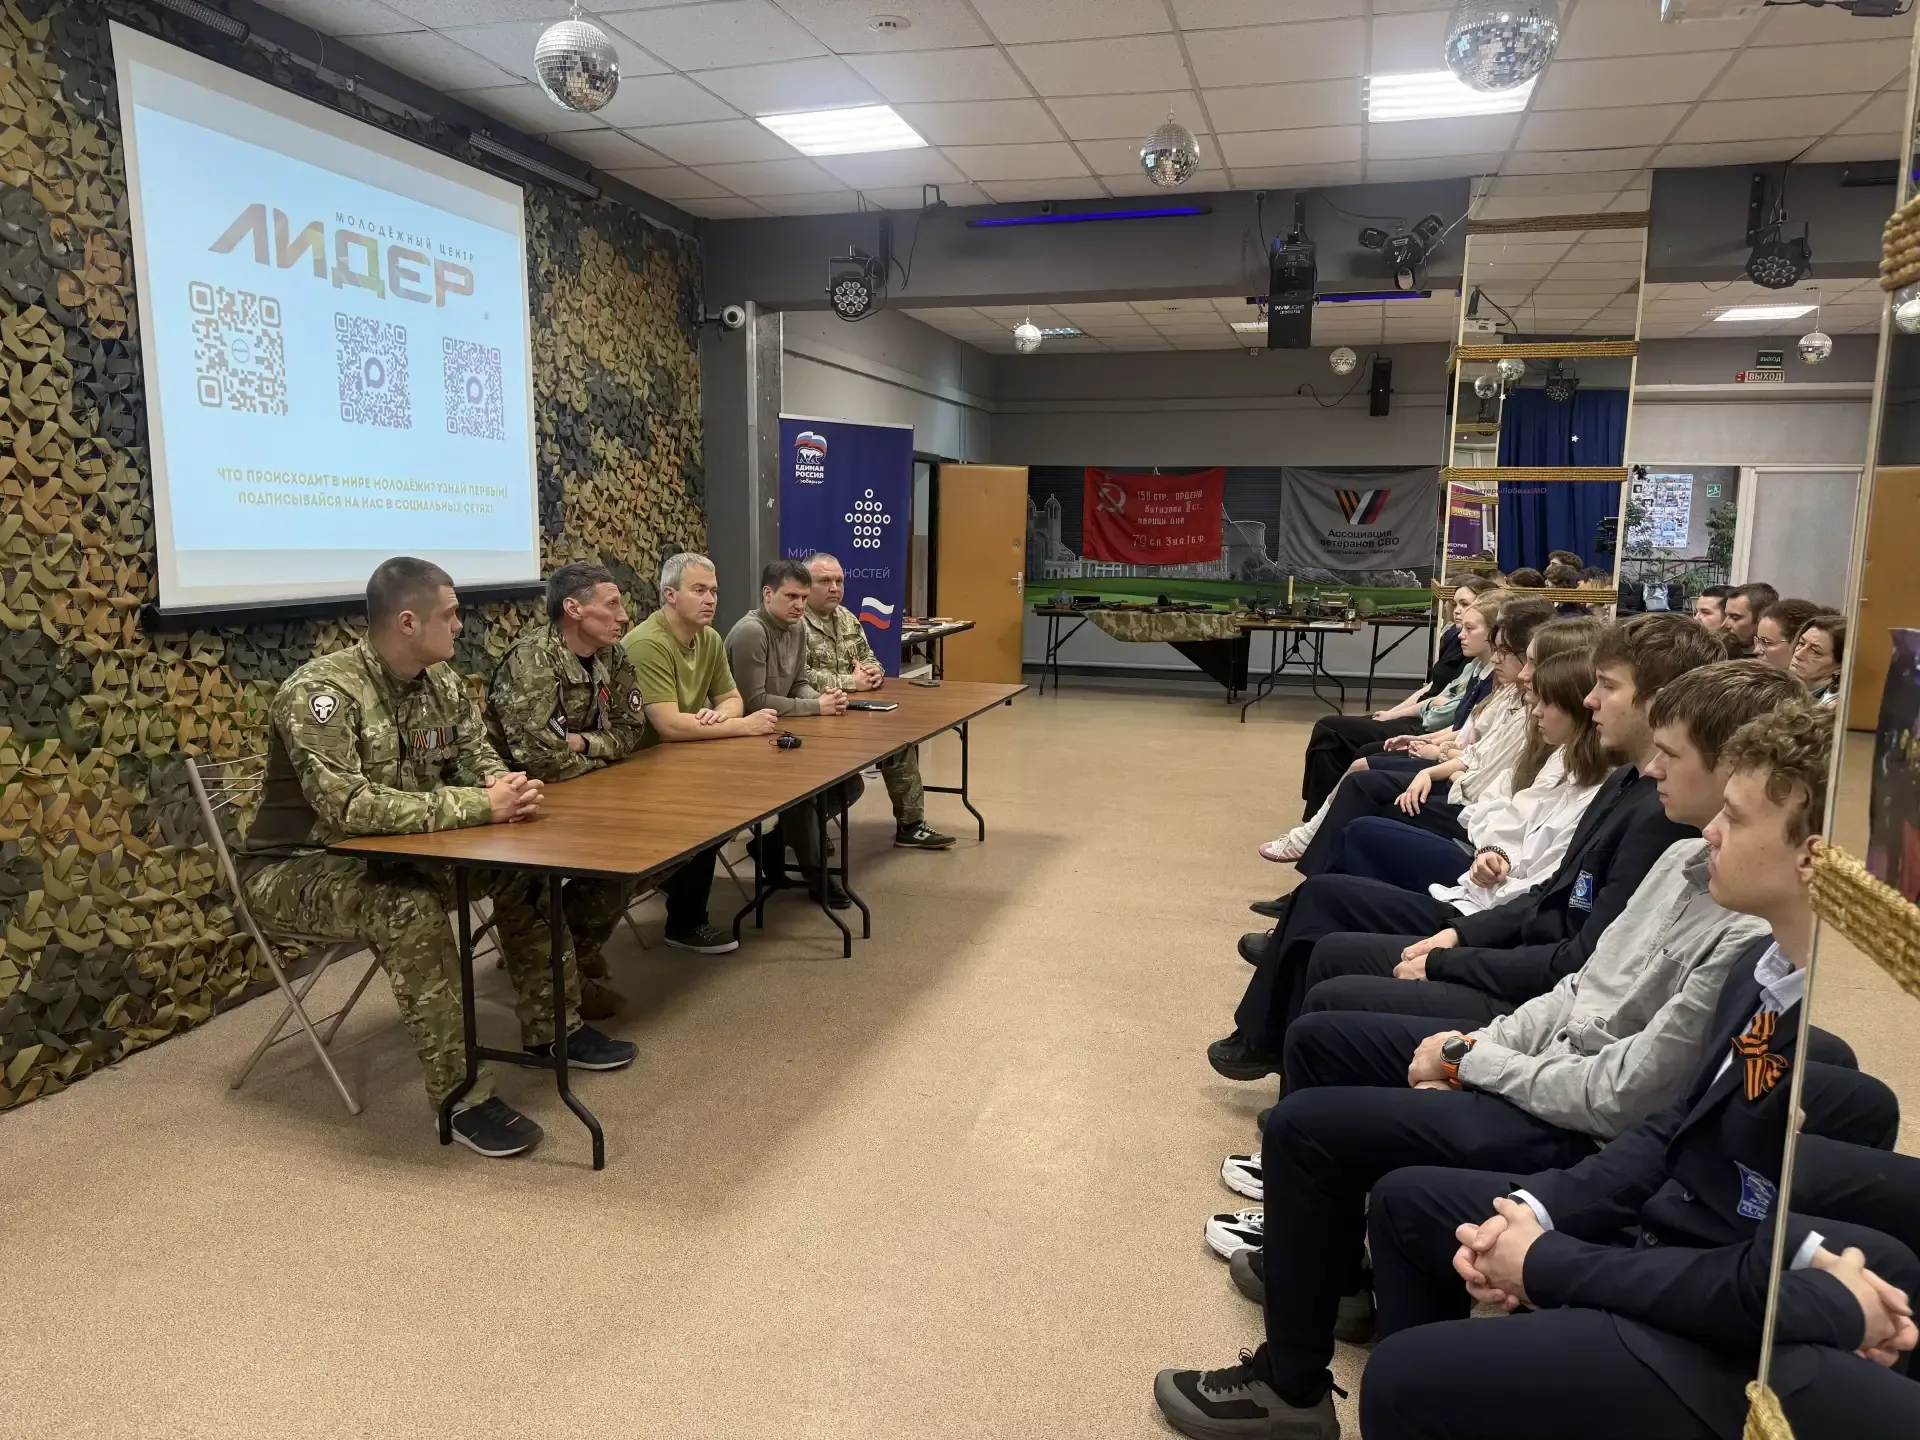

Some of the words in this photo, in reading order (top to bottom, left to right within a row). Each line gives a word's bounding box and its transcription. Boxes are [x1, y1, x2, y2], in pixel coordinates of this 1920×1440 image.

[335, 211, 432, 250] МОЛОДЁЖНЫЙ
[439, 243, 474, 262] ЦЕНТР
[208, 203, 474, 308] ЛИДЕР
[1749, 373, 1781, 381] ВЫХОД
[795, 464, 825, 472] ЕДИНАЯ
[217, 467, 242, 482] ЧТО
[246, 469, 329, 488] ПРОИСХОДИТ
[331, 475, 339, 487] В
[342, 476, 371, 489] МИРЕ
[437, 481, 467, 496] УЗНАЙ
[795, 471, 824, 479] РОССИЯ
[238, 491, 341, 508] ПОДПИСЫВАЙСЯ
[344, 496, 360, 508] НА
[362, 497, 383, 509] НАС
[386, 499, 393, 509] В
[395, 499, 460, 513] СОЦИАЛЬНЫХ
[1328, 529, 1392, 539] Ассоциация
[1132, 534, 1147, 548] 79
[1320, 539, 1375, 549] ветеранов
[1377, 536, 1400, 547] СВО
[844, 567, 891, 579] НОСТЕЙ
